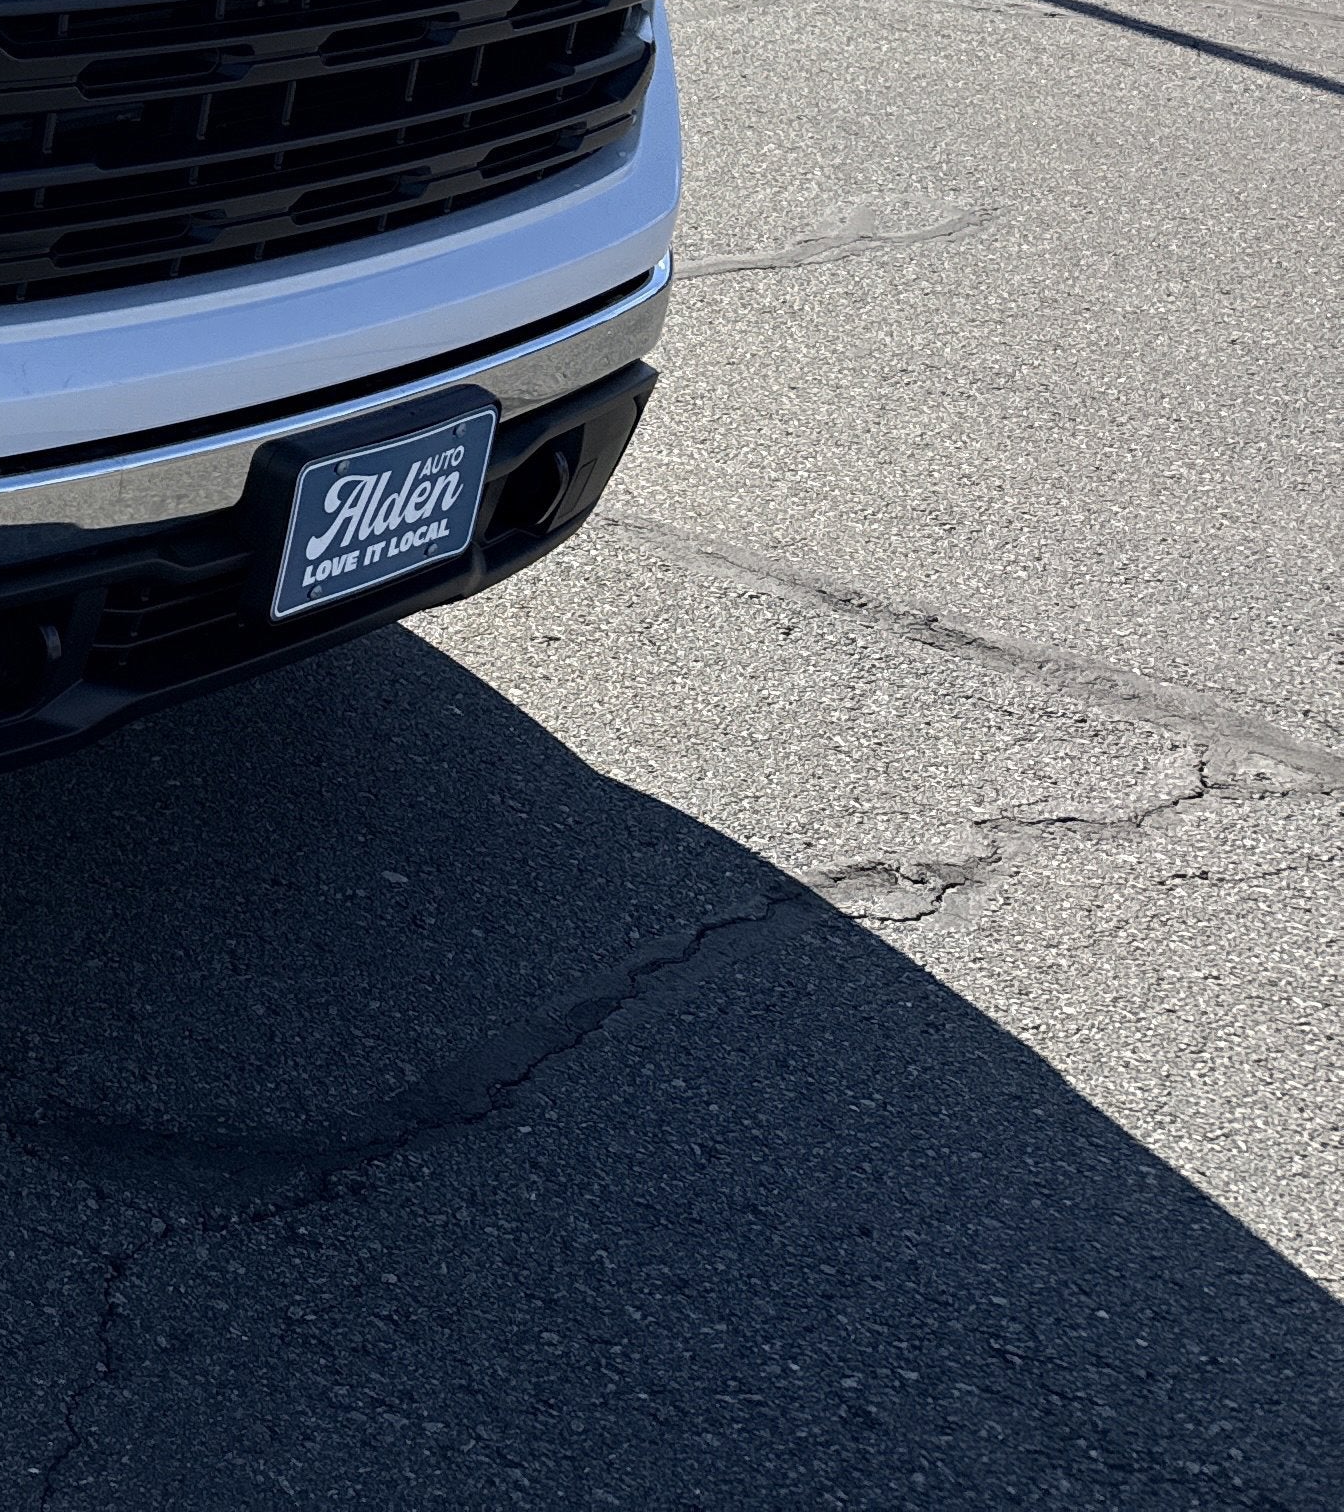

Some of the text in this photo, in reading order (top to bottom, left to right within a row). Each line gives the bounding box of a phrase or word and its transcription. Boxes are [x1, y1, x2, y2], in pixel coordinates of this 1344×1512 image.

[419, 445, 464, 479] AUTO
[306, 461, 463, 561] Alden
[302, 519, 449, 587] LOVE IT LOCAL
